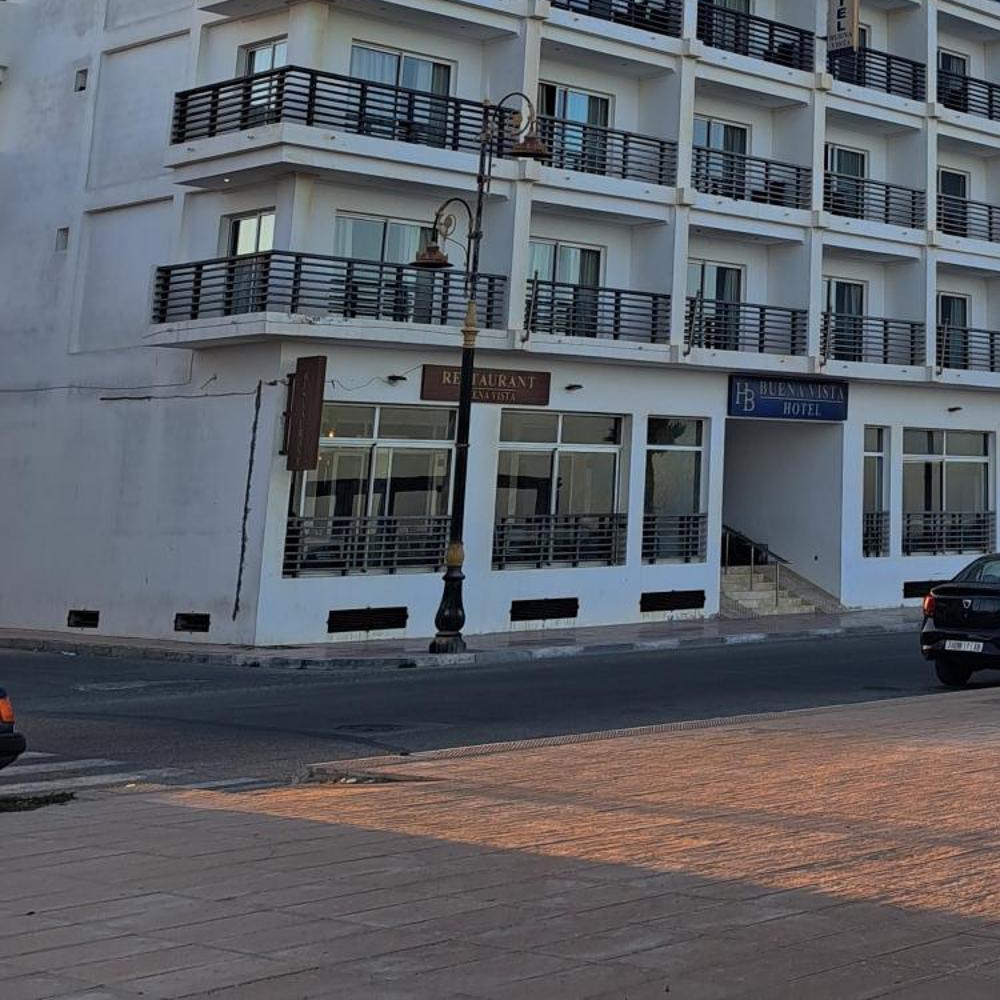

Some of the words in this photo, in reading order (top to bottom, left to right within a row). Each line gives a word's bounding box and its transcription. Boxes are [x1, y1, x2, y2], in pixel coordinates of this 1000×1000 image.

[442, 370, 535, 389] RETAURANT
[760, 381, 805, 398] BUENA
[807, 383, 844, 400] VISTA
[783, 401, 821, 417] HOTEL
